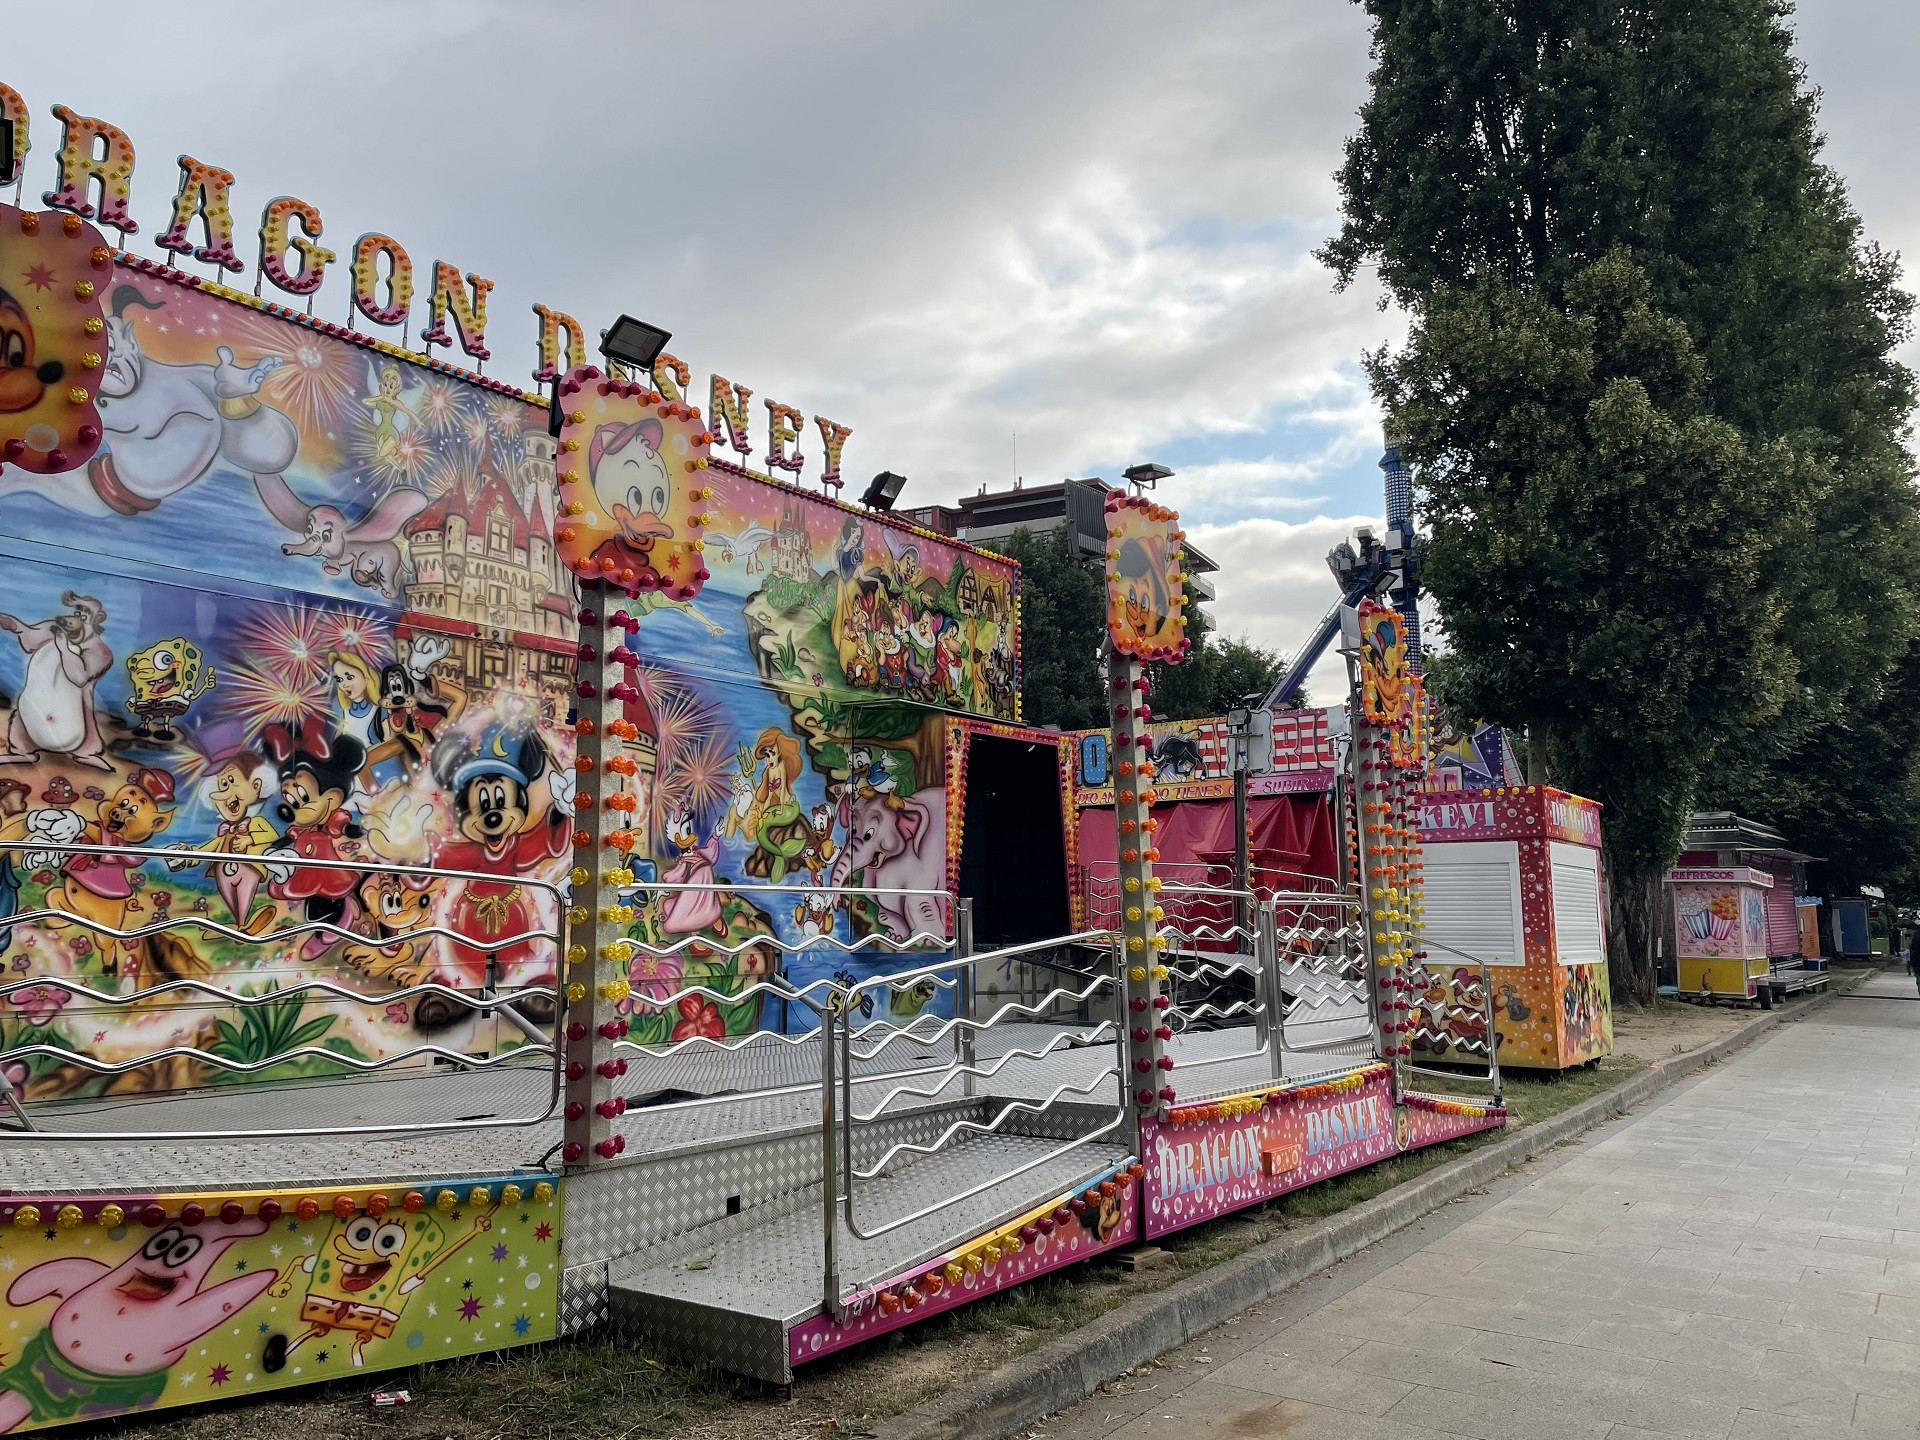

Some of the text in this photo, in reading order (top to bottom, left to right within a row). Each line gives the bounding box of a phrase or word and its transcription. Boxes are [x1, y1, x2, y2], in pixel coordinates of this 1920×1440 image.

[532, 302, 853, 488] DSNEY
[1174, 784, 1222, 799] TIENES
[1416, 801, 1497, 830] KEVI
[1551, 801, 1594, 834] DRAGON
[1671, 871, 1735, 880] REFRESCOS
[1156, 1095, 1381, 1201] DRAGON DISNEY
